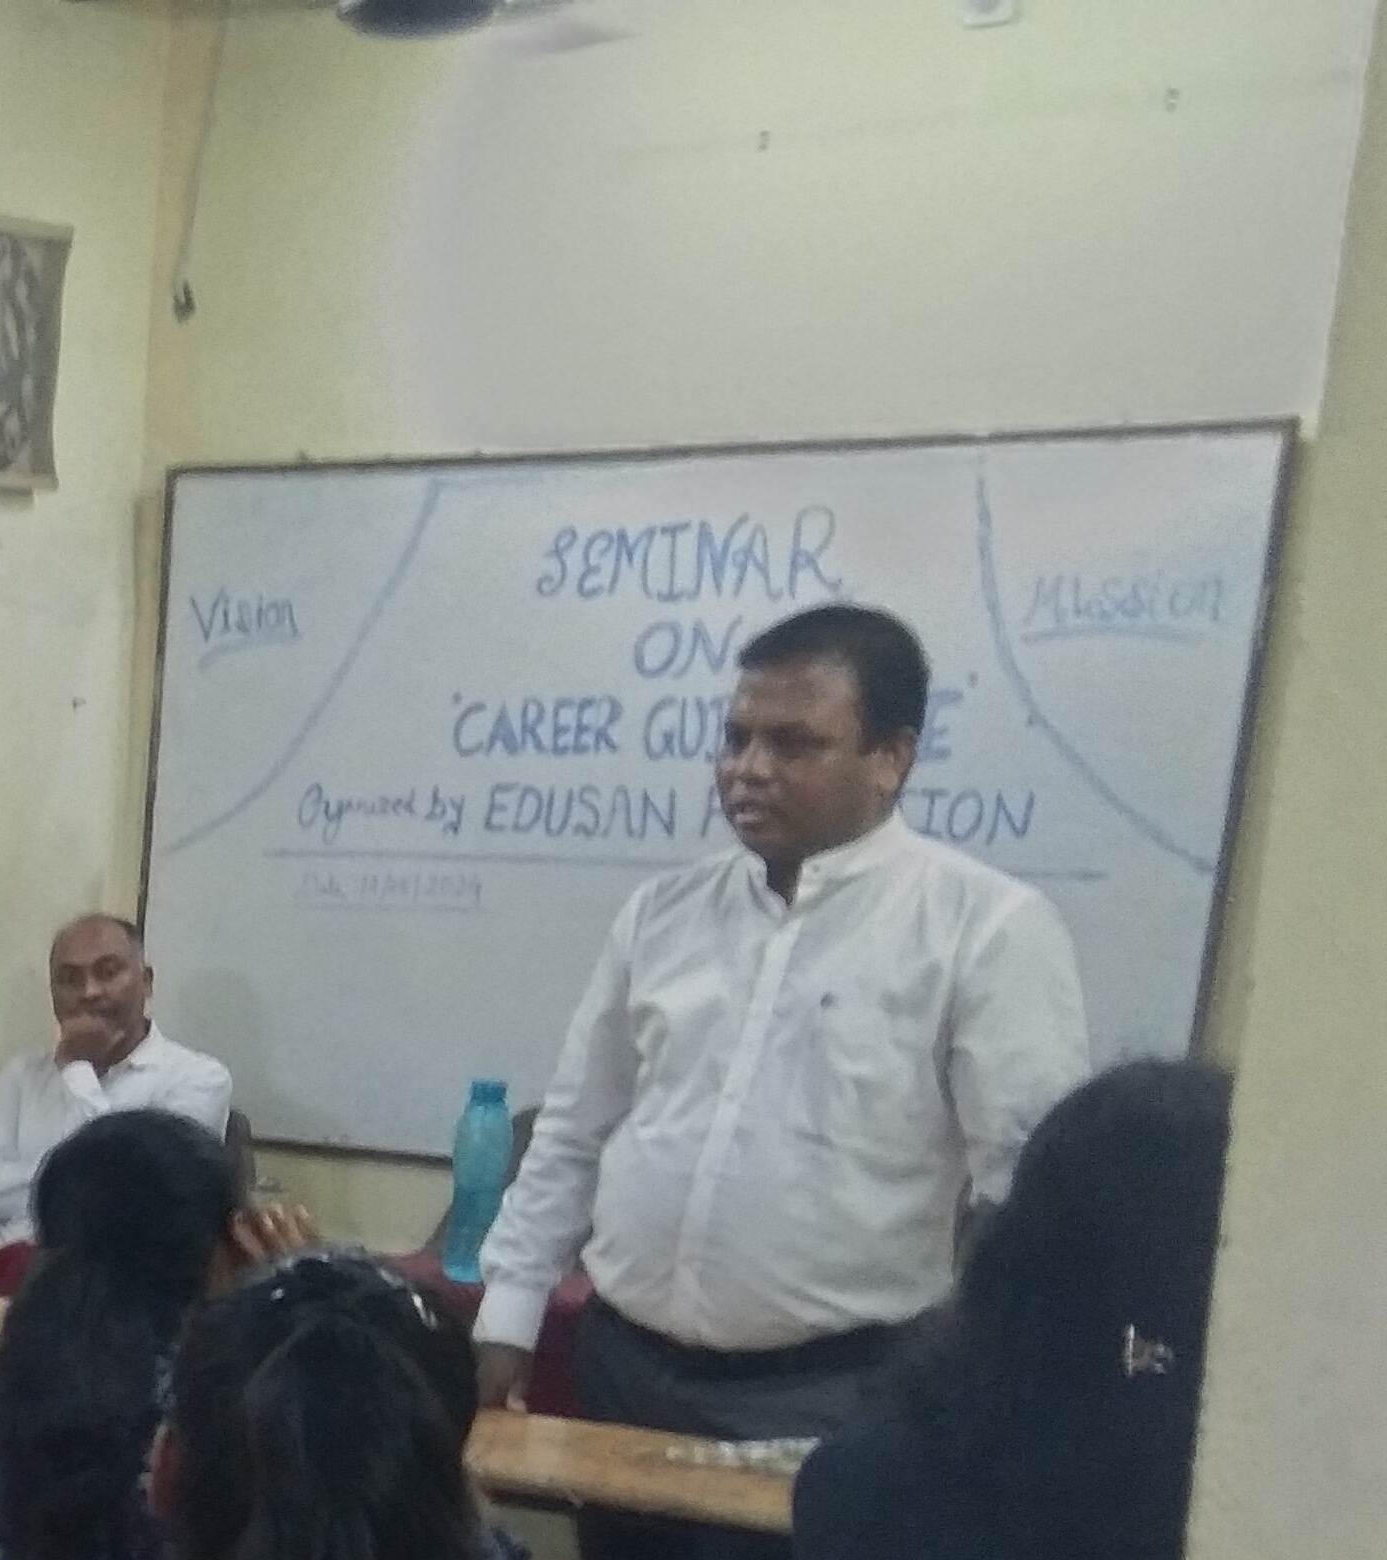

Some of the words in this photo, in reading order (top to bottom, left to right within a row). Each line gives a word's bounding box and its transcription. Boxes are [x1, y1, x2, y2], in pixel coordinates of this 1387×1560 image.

[536, 505, 843, 602] SEMINAR
[190, 586, 302, 644] Vision
[633, 616, 742, 679] ON
[424, 783, 466, 837] by
[483, 782, 676, 839] EDUSAN
